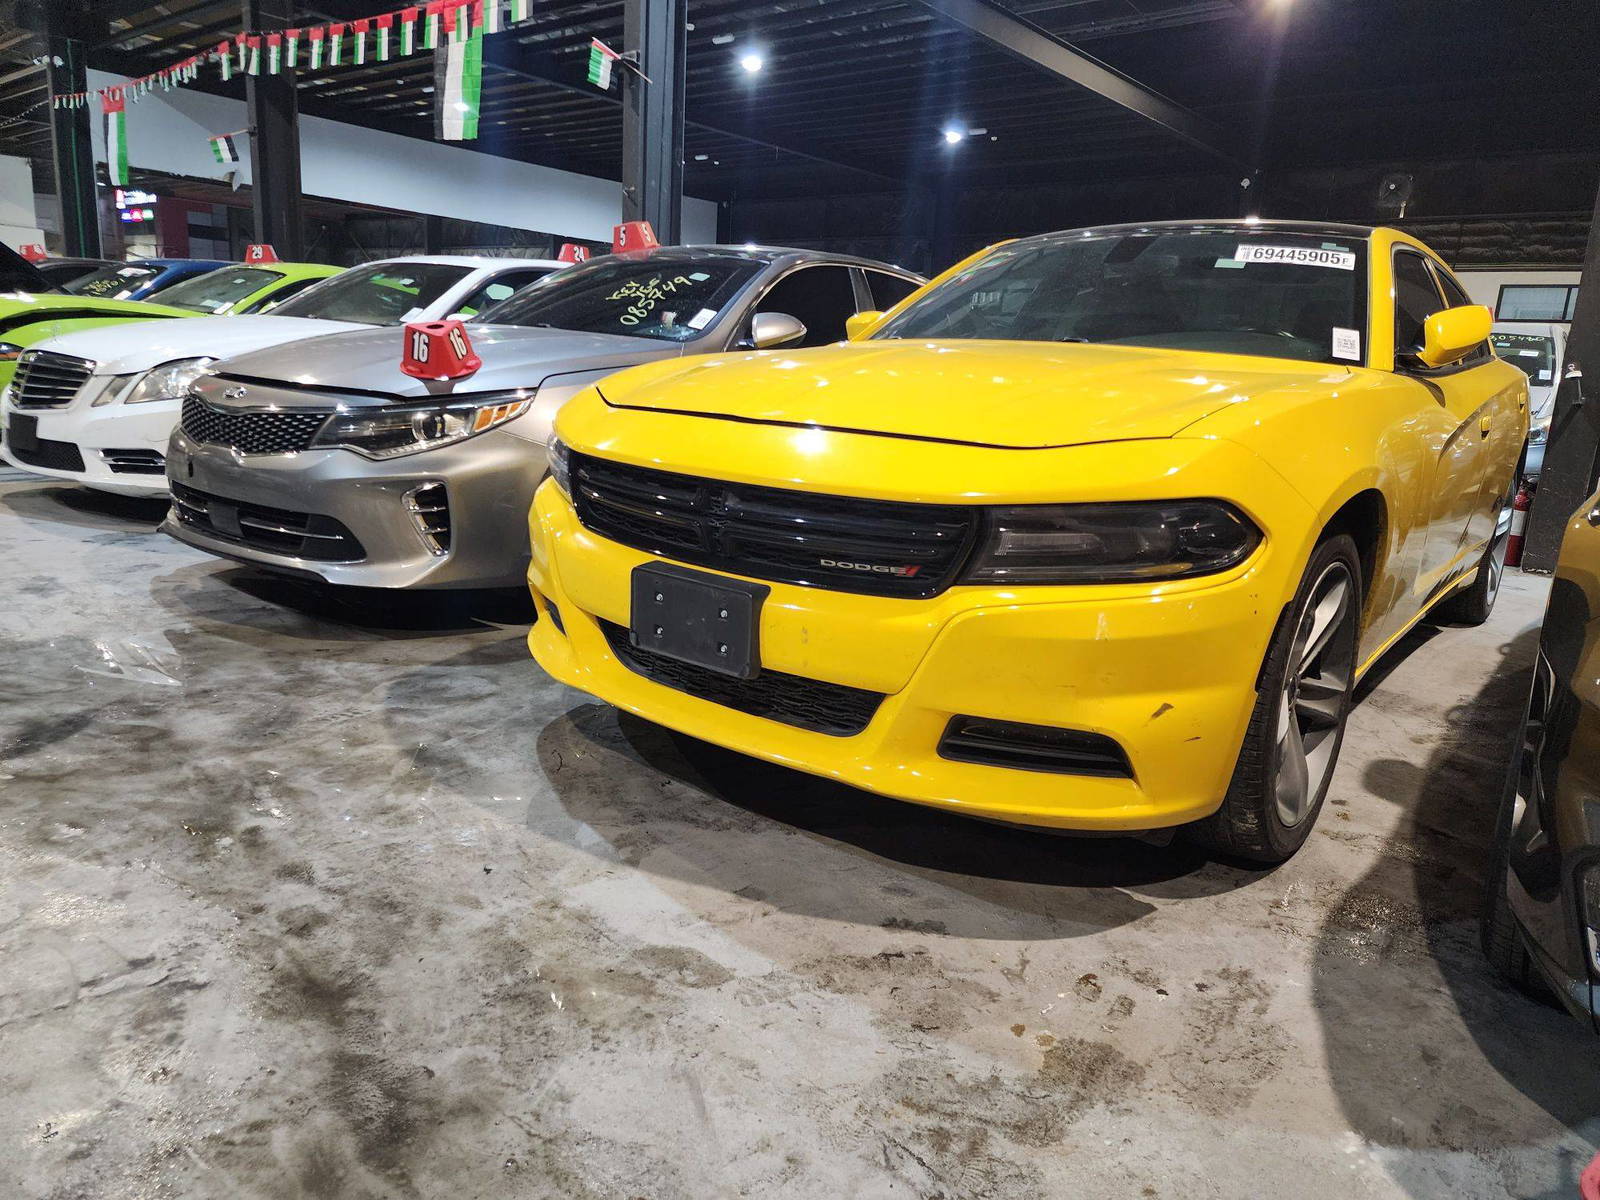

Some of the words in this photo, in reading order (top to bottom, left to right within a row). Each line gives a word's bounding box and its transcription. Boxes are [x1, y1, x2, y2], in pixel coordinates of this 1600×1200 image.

[619, 226, 626, 247] 5
[252, 246, 263, 259] 29
[574, 247, 585, 262] 24
[620, 276, 692, 325] 085749
[412, 331, 429, 363] 16
[449, 327, 467, 360] 16
[820, 559, 907, 574] DODGE
